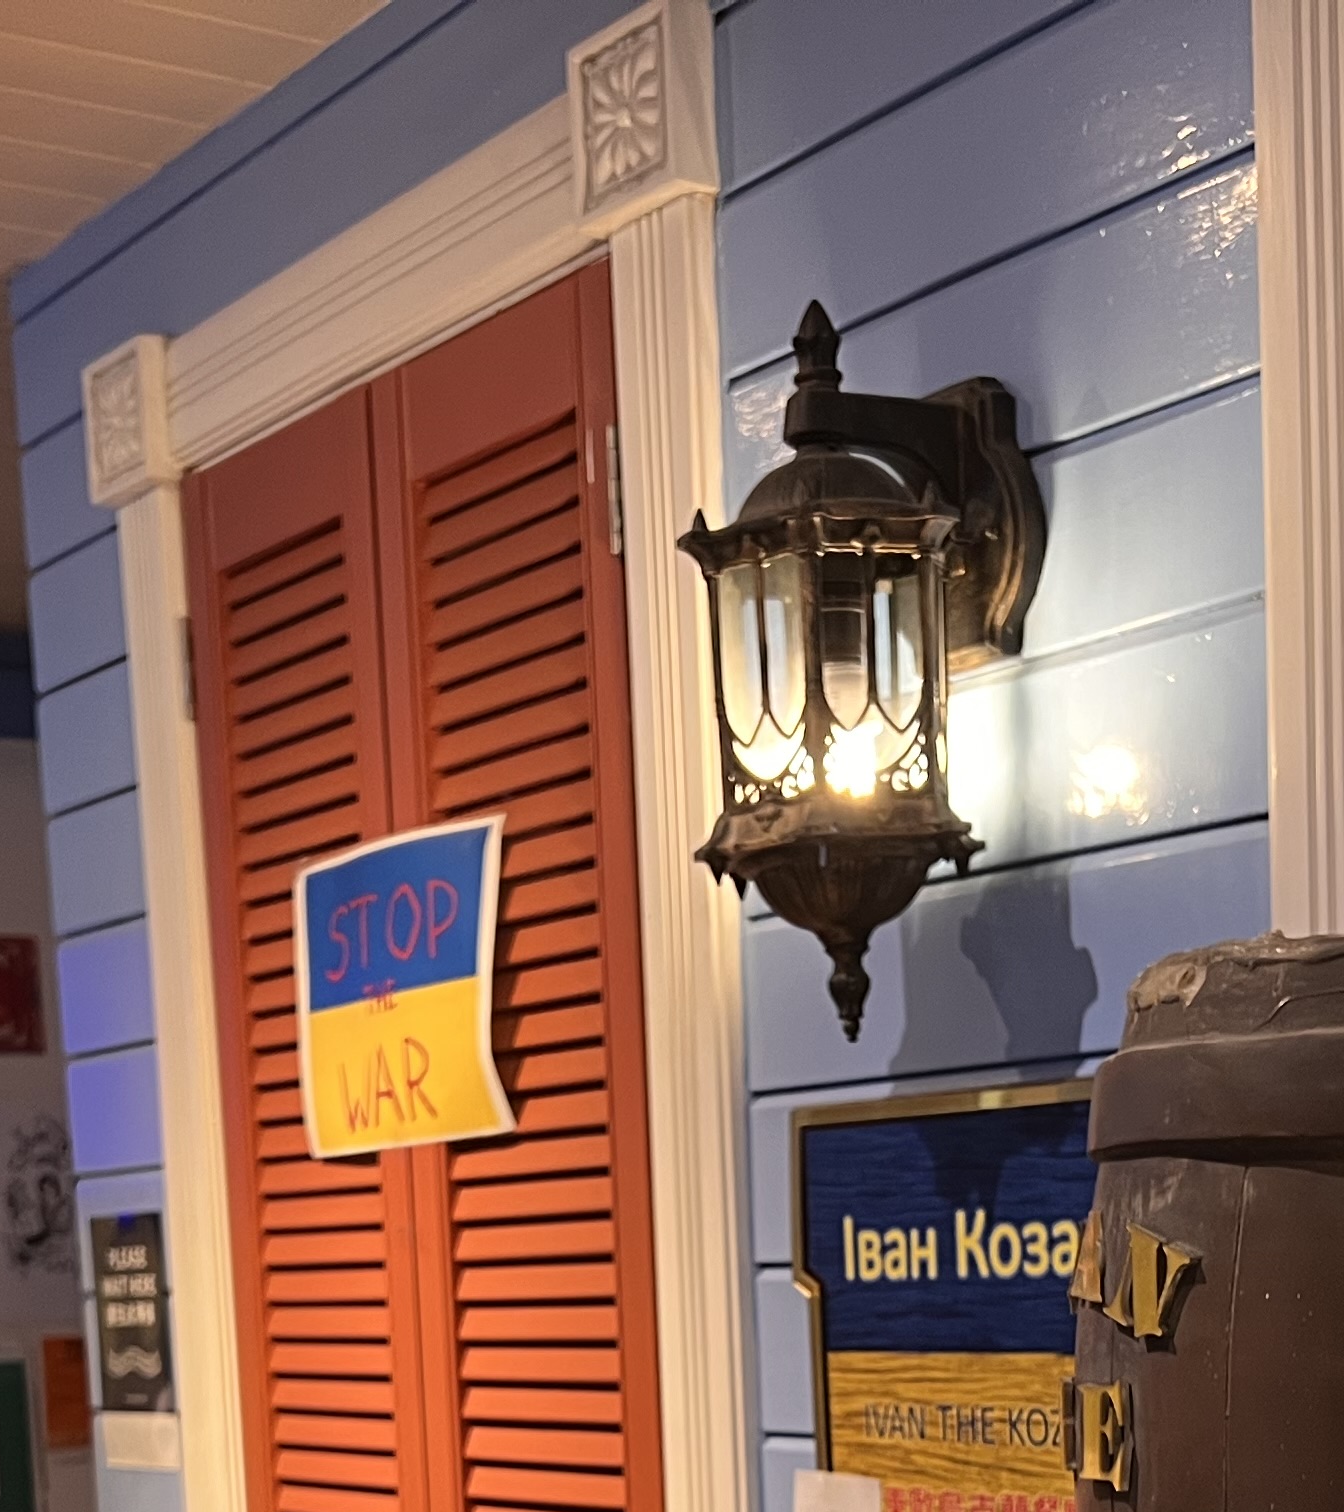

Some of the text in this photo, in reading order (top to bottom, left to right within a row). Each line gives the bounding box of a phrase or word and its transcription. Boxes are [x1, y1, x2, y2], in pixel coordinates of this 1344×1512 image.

[324, 879, 459, 983] STOP
[362, 978, 398, 1015] THE
[338, 1036, 439, 1135] WAR
[842, 1214, 939, 1282] Іван
[864, 1402, 927, 1440] IVAN
[936, 1404, 996, 1446] THE
